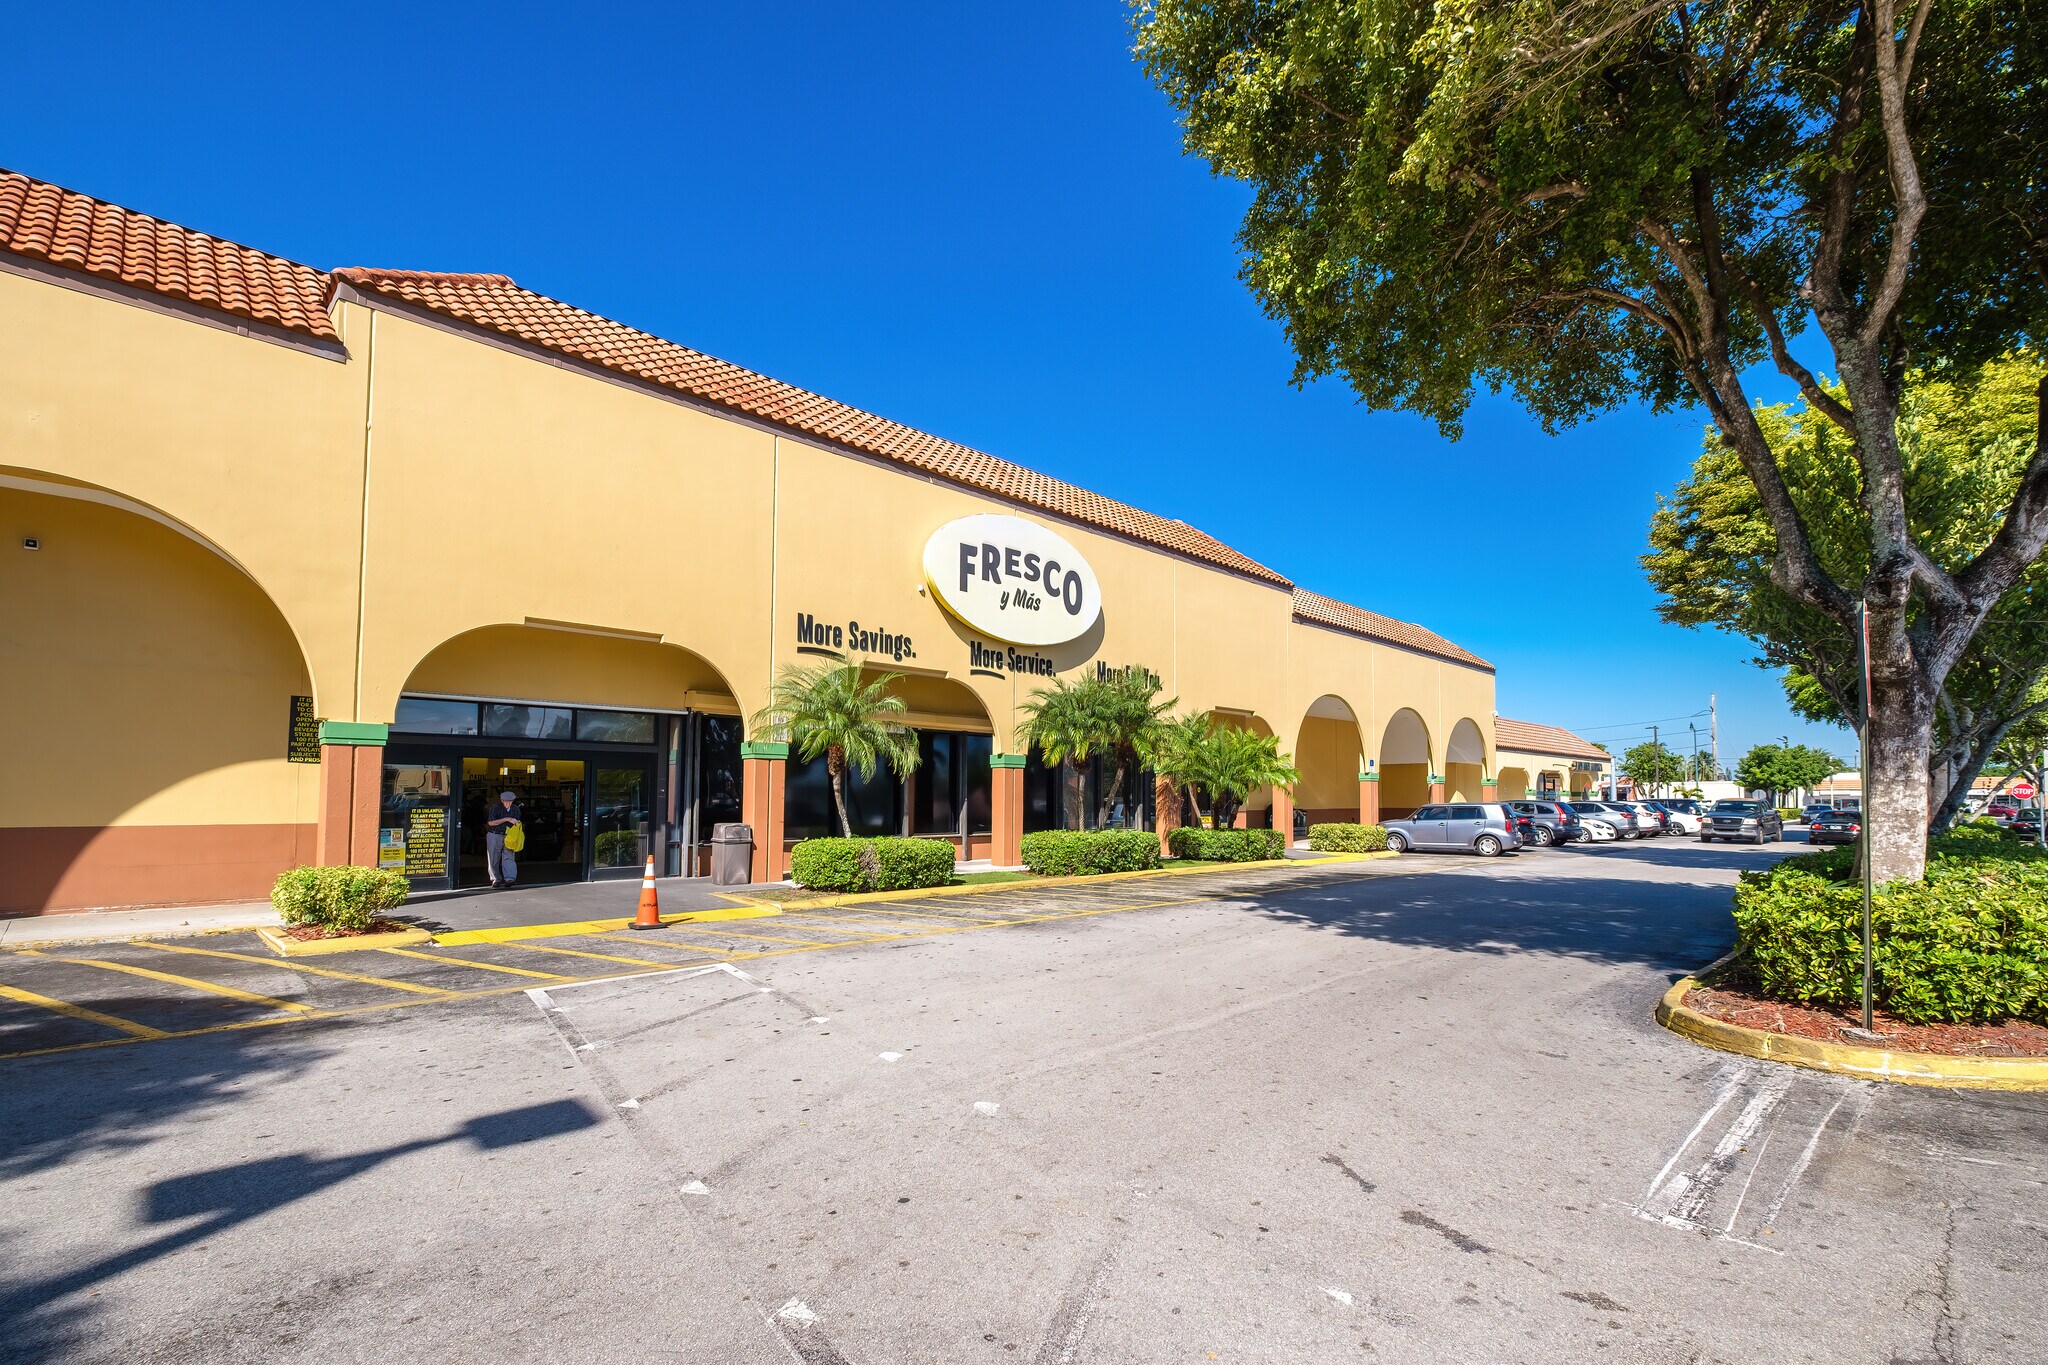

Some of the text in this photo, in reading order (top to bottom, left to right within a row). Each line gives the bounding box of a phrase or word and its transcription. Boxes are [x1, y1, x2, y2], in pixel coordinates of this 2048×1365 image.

[960, 543, 1083, 615] FRESCO
[1000, 588, 1041, 611] y Más
[797, 613, 916, 662] More Savings.
[970, 641, 1056, 677] More Service.
[1097, 661, 1123, 684] More
[2013, 787, 2034, 795] STOP
